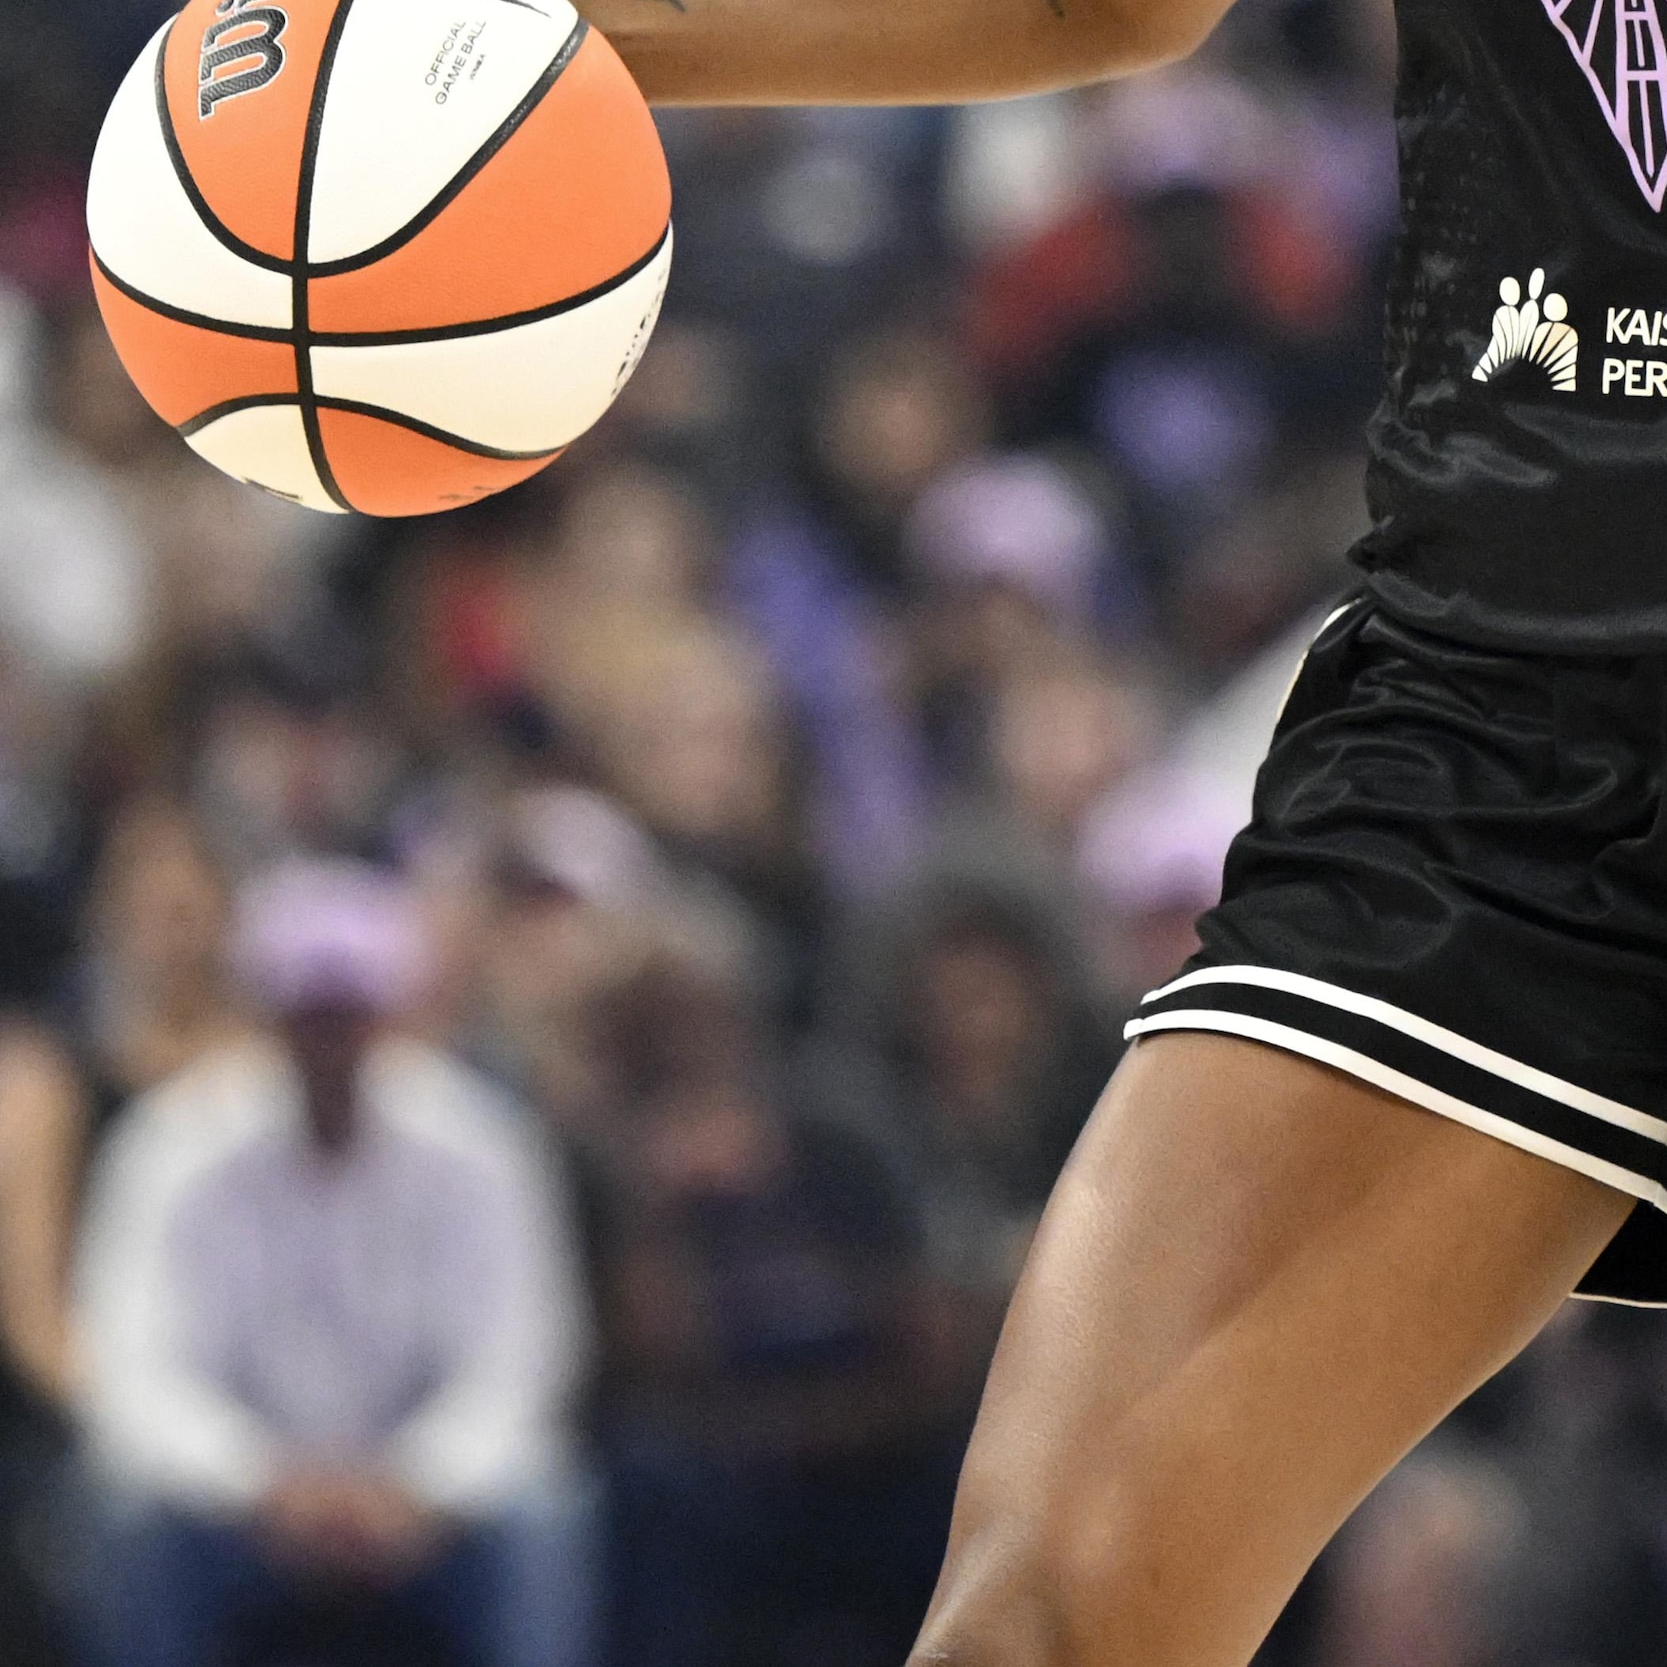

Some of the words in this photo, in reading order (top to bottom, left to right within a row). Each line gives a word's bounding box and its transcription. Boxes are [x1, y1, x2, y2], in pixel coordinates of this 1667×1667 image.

[424, 21, 467, 86] OFFICIAL
[435, 54, 467, 105] GAME
[460, 21, 486, 55] BALL
